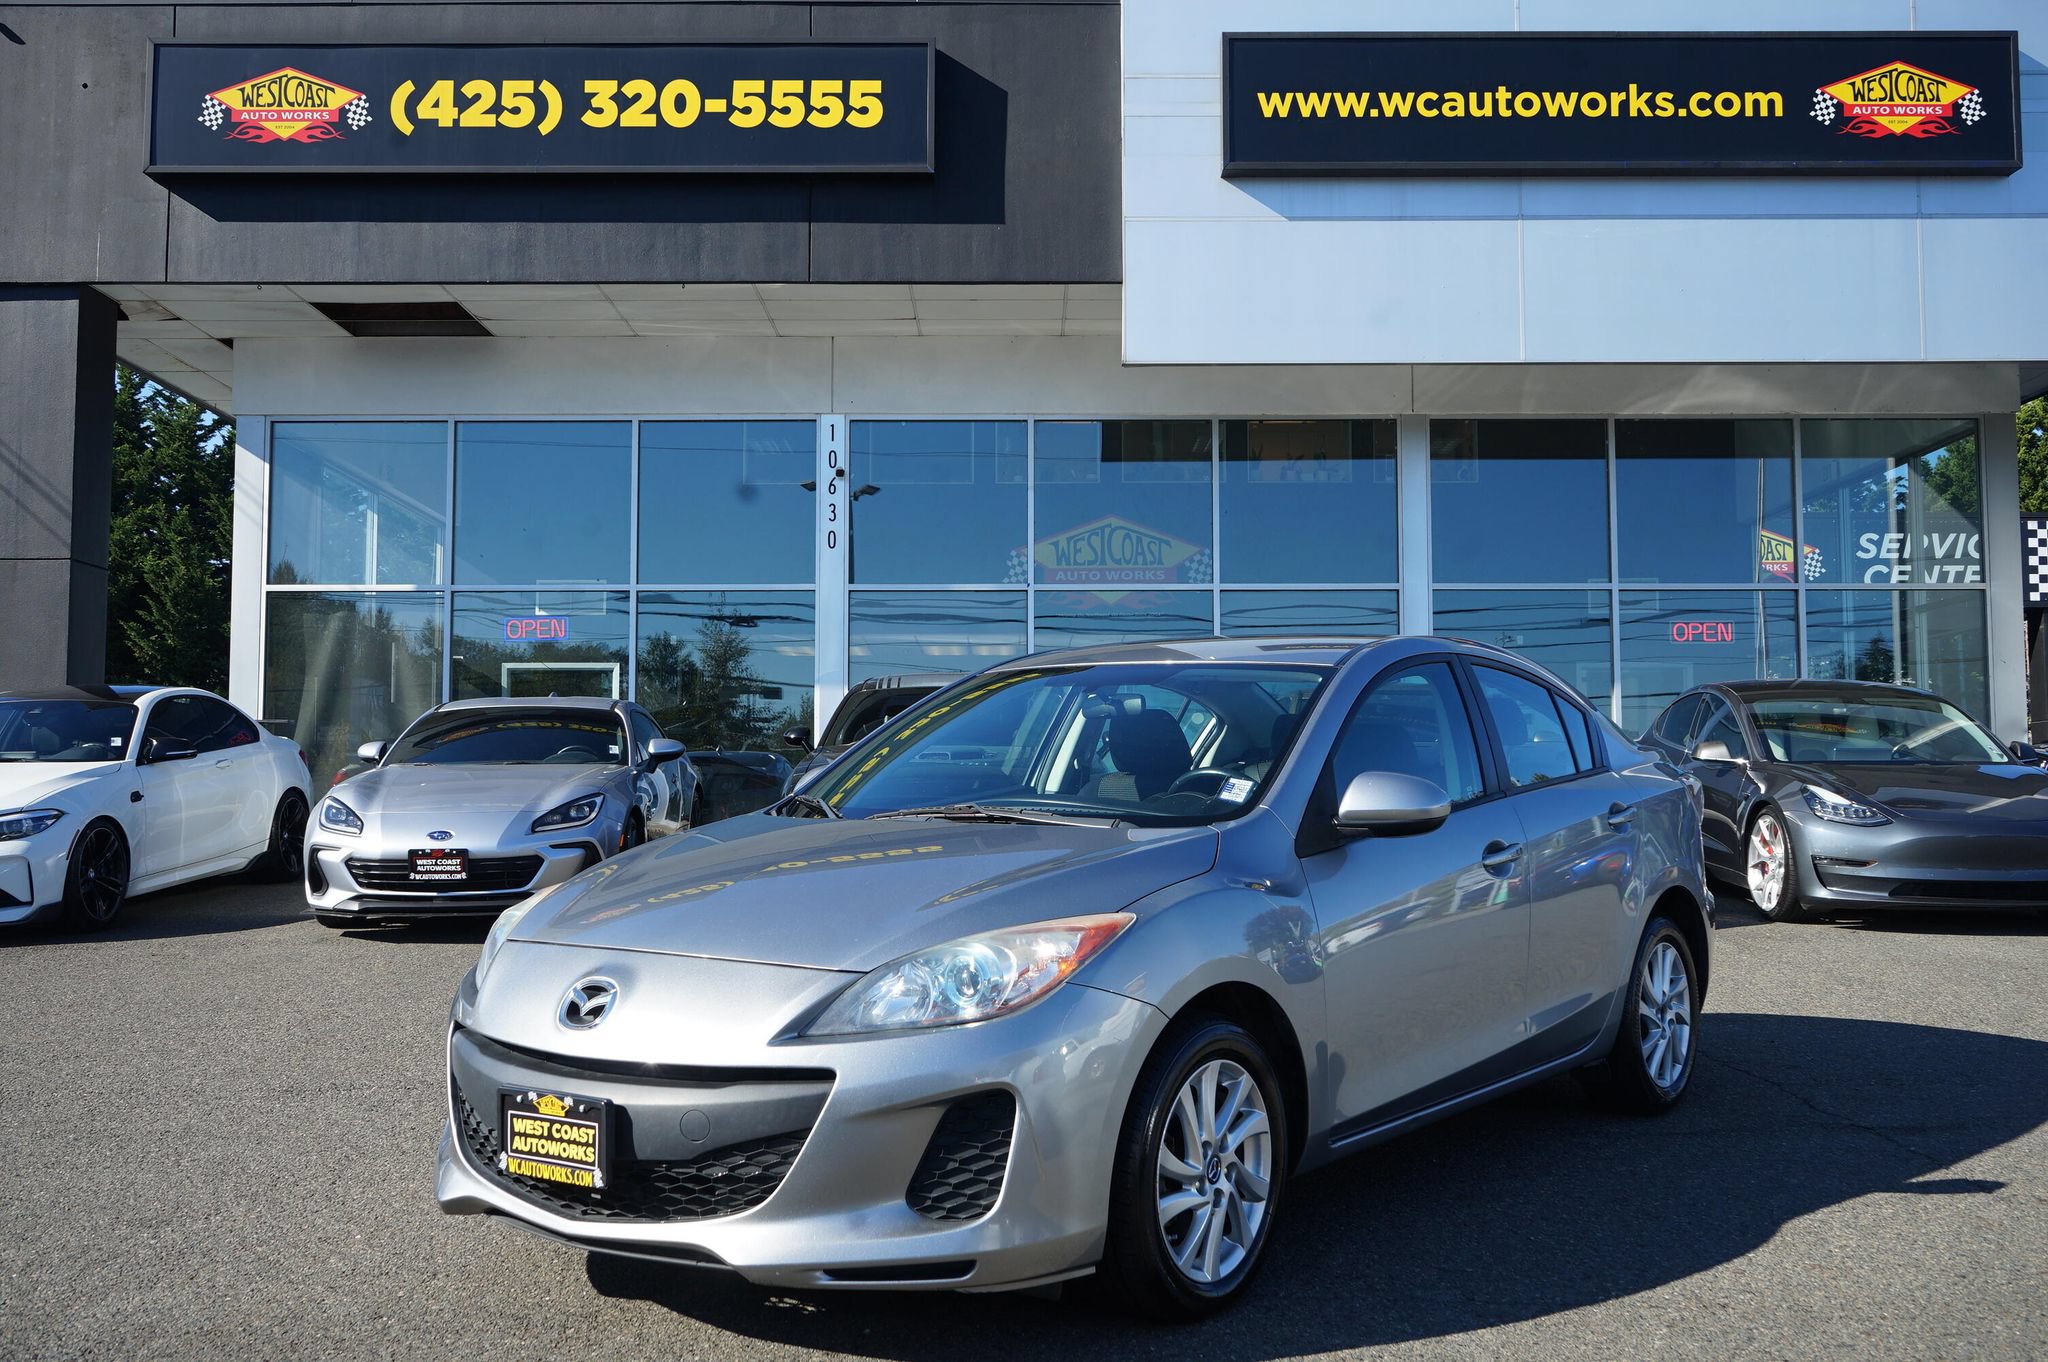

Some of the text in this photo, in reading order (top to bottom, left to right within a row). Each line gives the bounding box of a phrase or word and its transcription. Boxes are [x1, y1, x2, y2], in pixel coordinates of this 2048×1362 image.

[389, 79, 884, 137] (425) 320-5555
[1256, 83, 1784, 118] www.wcautoworks.com
[1853, 106, 1943, 115] AUTO WORKS
[240, 111, 330, 121] AUTO WORKS
[1055, 570, 1166, 581] AUTO WORKS
[506, 619, 565, 639] OPEN
[1672, 622, 1732, 642] OPEN
[512, 1117, 595, 1144] WEST COAST
[512, 1135, 595, 1163] AUTOWORKS
[507, 1157, 593, 1188] WCAUTOWORKS.COM
